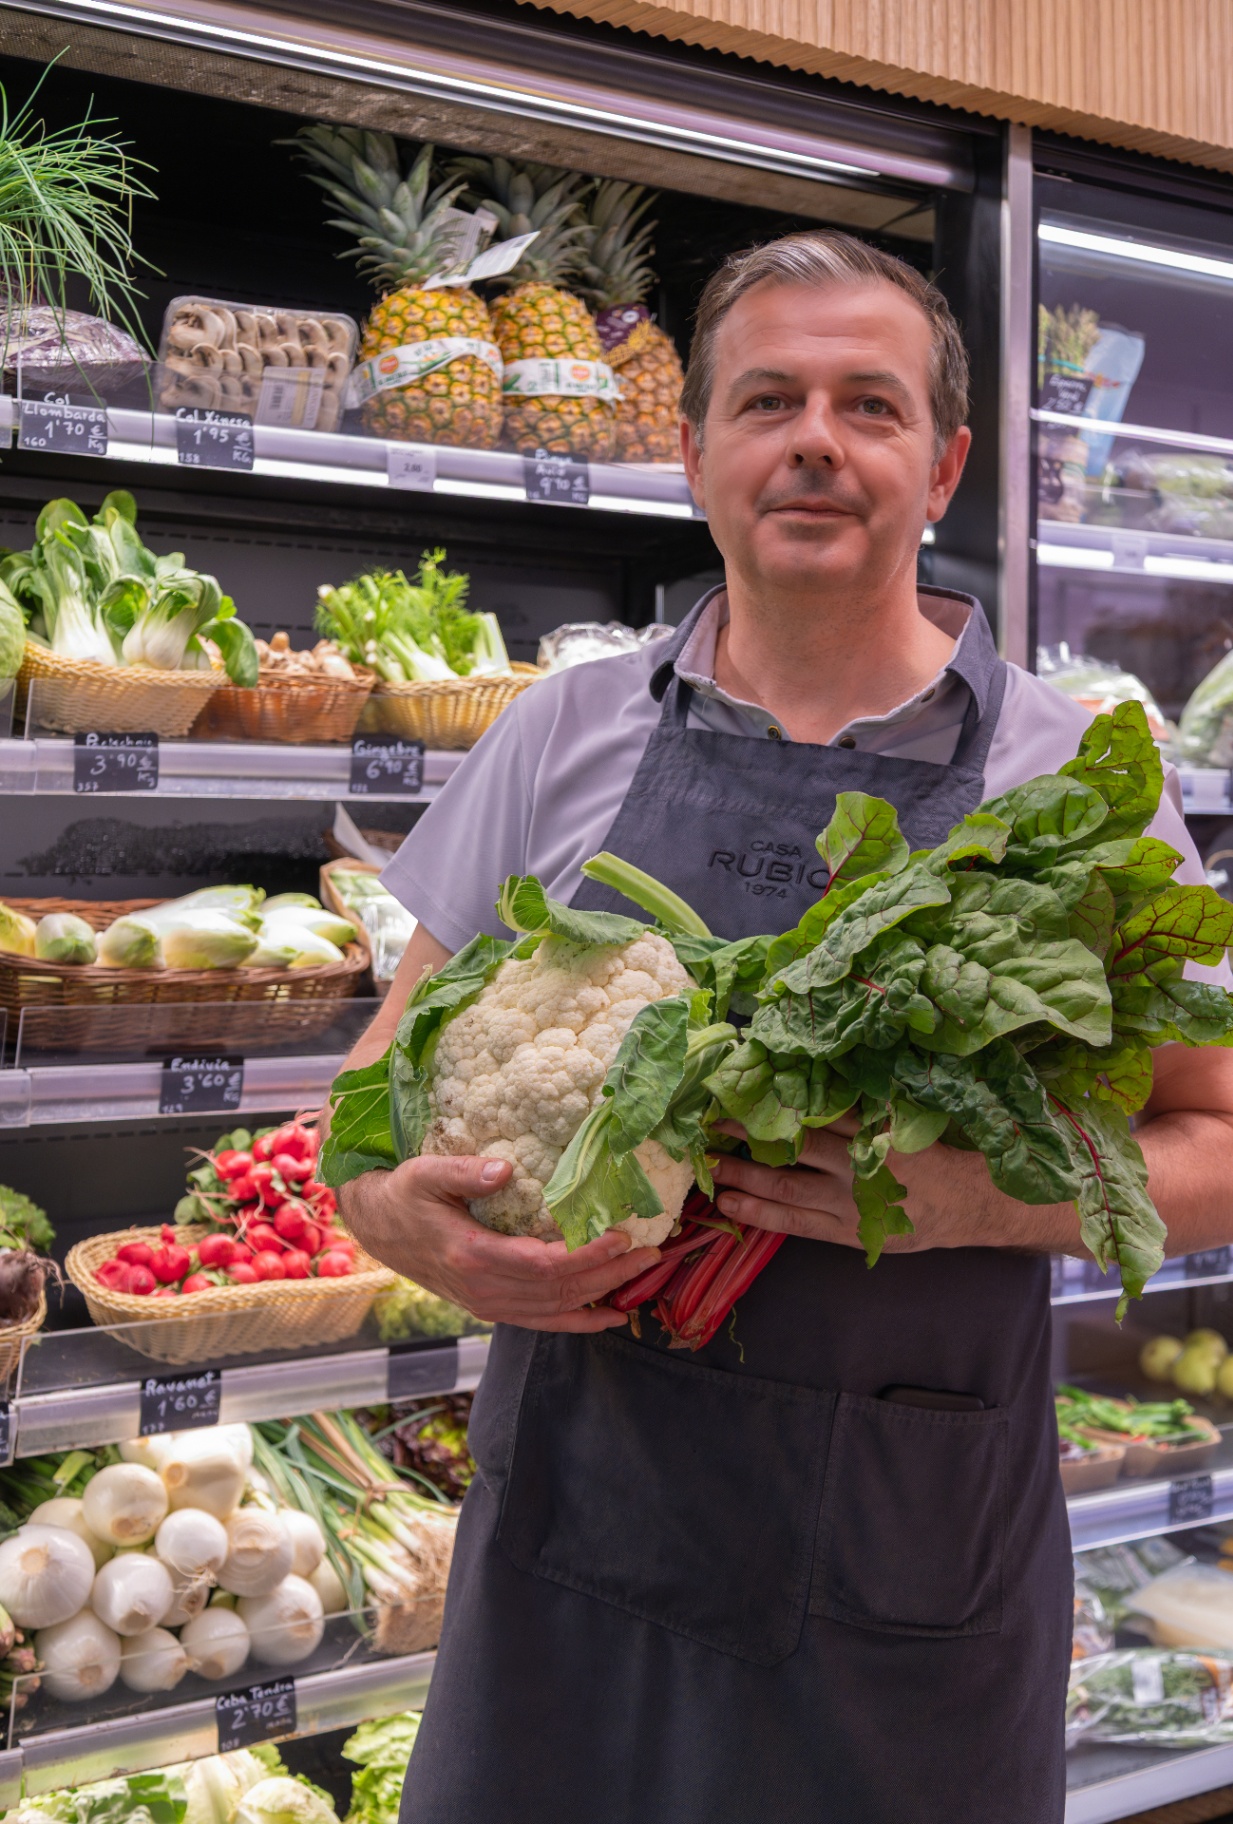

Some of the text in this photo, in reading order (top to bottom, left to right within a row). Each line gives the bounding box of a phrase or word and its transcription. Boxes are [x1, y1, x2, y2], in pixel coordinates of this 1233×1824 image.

[43, 391, 70, 405] Col
[24, 402, 105, 423] Llombarda
[23, 437, 47, 447] 160
[750, 840, 802, 858] CASA
[744, 882, 787, 898] 1974
[171, 1058, 230, 1072] Endivia
[145, 1370, 215, 1397] Ravanet
[217, 1682, 294, 1711] Ceba Tendra
